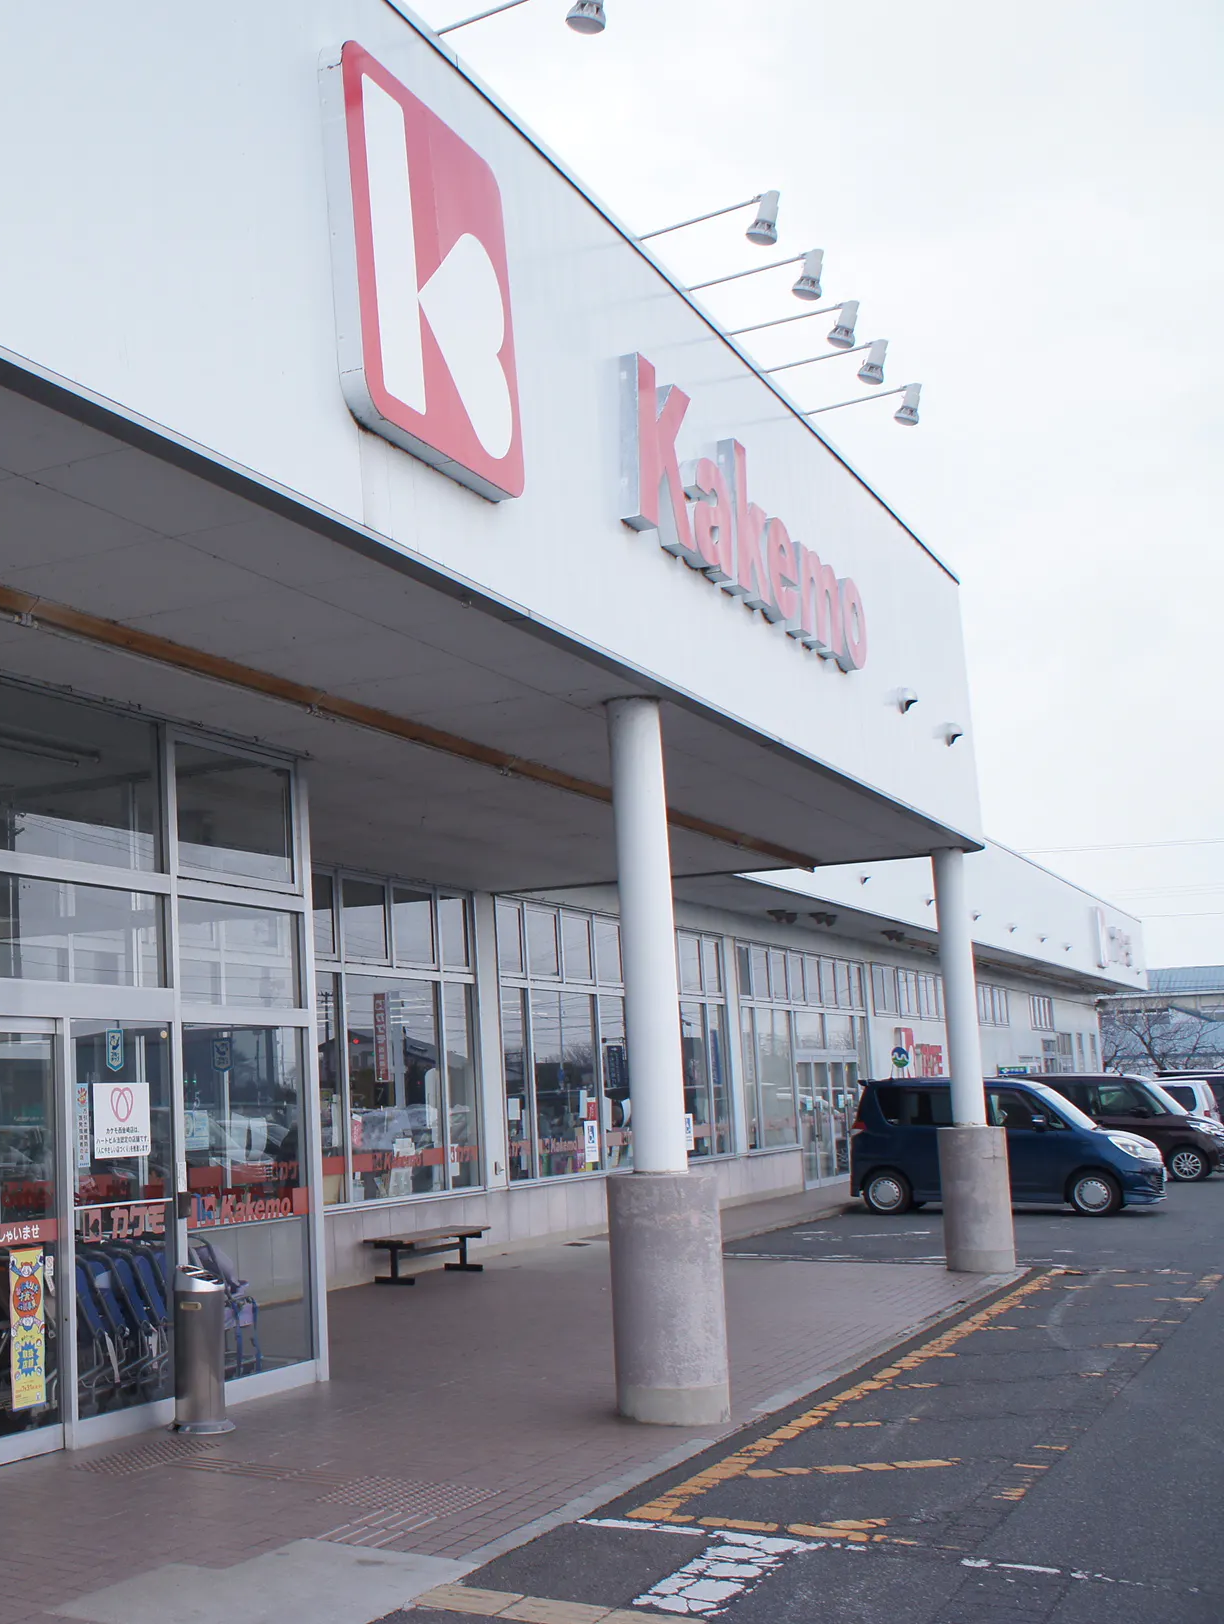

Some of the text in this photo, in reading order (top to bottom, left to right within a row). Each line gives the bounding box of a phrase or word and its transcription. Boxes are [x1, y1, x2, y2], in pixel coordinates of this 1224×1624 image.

[622, 352, 867, 673] Kakemo
[111, 1204, 166, 1240] カケモ
[219, 1194, 293, 1226] Kakemo
